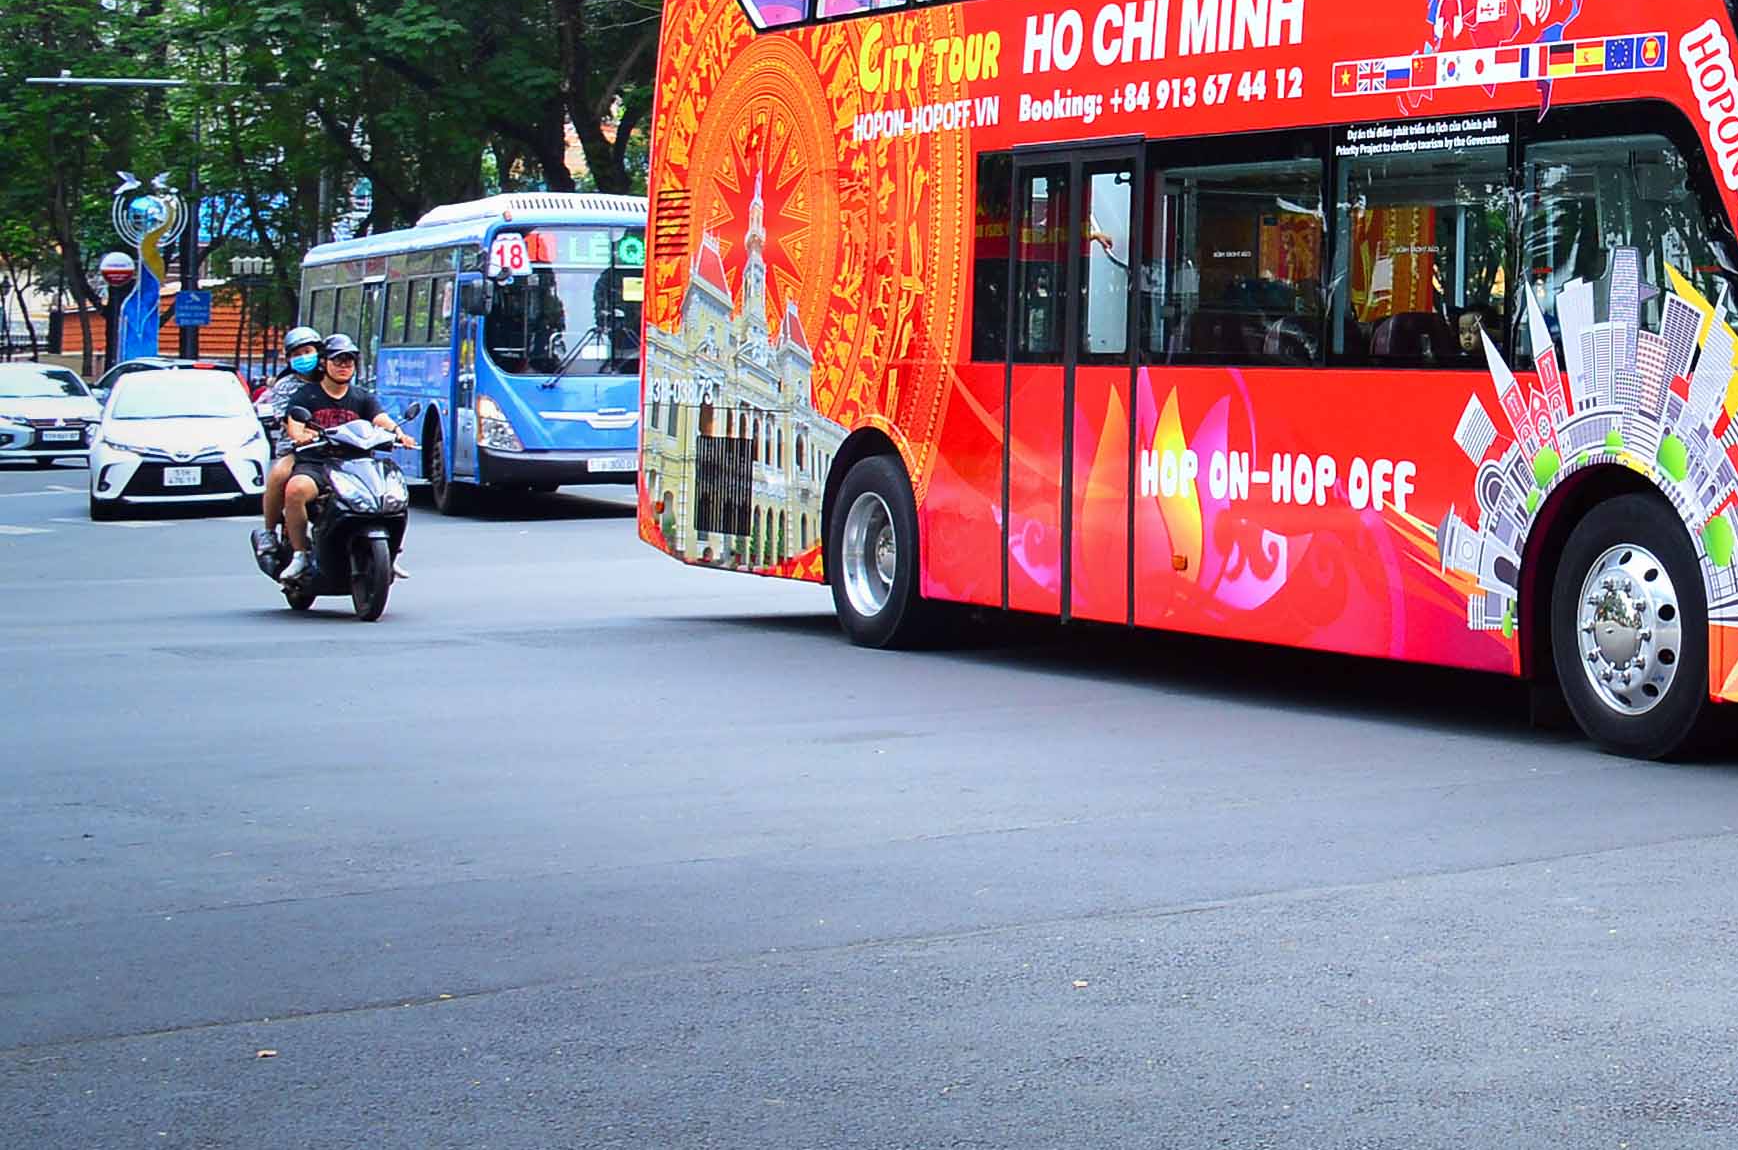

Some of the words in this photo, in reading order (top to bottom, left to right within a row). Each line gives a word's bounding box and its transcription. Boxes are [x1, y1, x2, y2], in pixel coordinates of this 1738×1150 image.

[859, 22, 925, 93] CITY
[933, 31, 1000, 86] TOUR
[1022, 9, 1084, 75] HO
[853, 96, 1000, 141] HOPON-HOPOFF.VN
[1019, 89, 1103, 123] Booking:
[1110, 81, 1150, 114] +84
[1156, 77, 1196, 110] 913
[1203, 73, 1232, 105] 67
[1237, 69, 1266, 101] 44
[1275, 66, 1303, 99] 12
[1336, 144, 1359, 157] Priority
[1360, 143, 1382, 156] Project
[1383, 142, 1391, 152] to
[1391, 139, 1417, 153] develop
[1418, 137, 1443, 150] tourism
[1444, 136, 1453, 150] by
[1454, 135, 1465, 147] the
[1466, 133, 1510, 146] Government
[495, 243, 523, 270] 18
[1140, 449, 1198, 498] HOP
[1348, 456, 1417, 514] OFF
